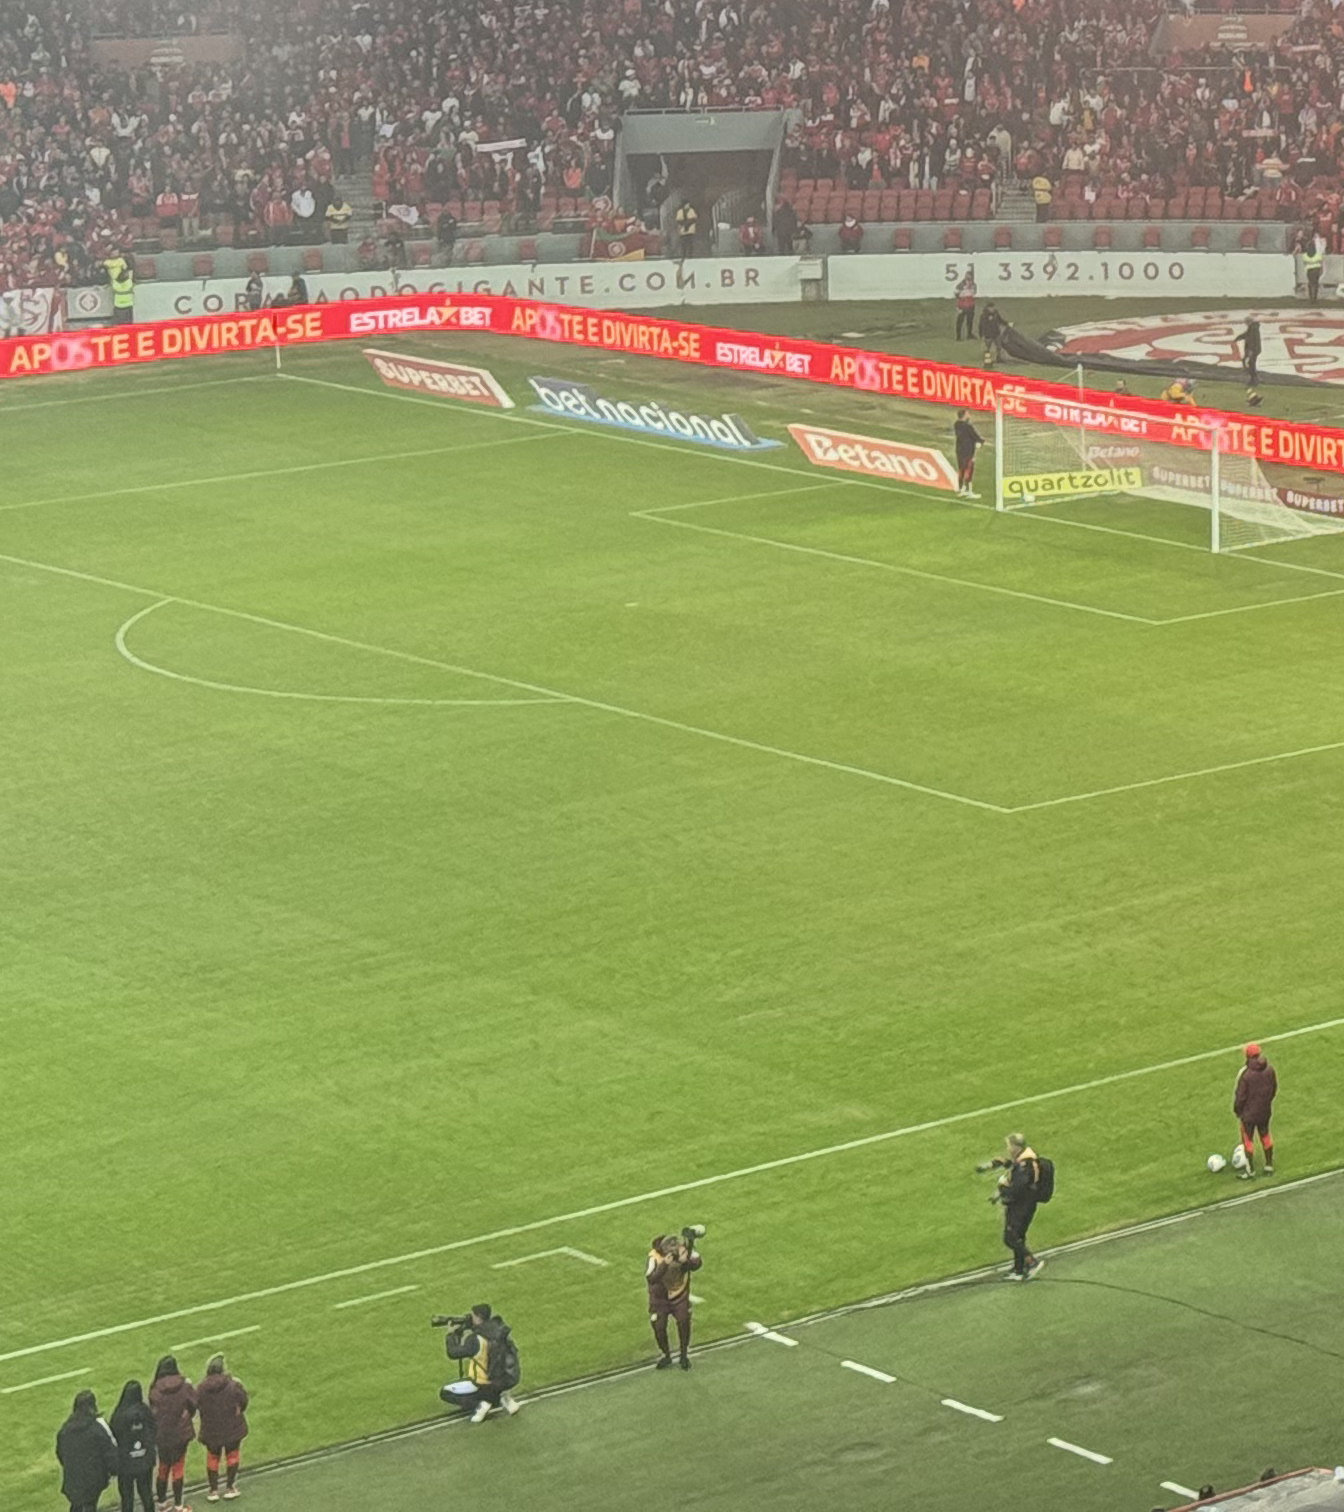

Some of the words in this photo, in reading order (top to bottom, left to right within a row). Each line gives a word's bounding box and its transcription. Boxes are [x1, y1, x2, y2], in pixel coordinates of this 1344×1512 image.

[998, 261, 1186, 281] 3392.1000
[10, 333, 130, 373] APOSTE
[137, 331, 156, 358] E
[162, 311, 323, 356] DIVIRTA-SE
[511, 306, 585, 344] APOSTE
[587, 317, 600, 343] E
[602, 319, 700, 359] DIVIRTA-SE
[373, 357, 487, 398] SUPERBET
[830, 353, 904, 391] APOSTE
[907, 367, 919, 394] E
[803, 431, 938, 482] Betano
[1260, 427, 1274, 457] E
[1007, 466, 1137, 498] quartzolit
[1286, 490, 1344, 514] SUPERBET
